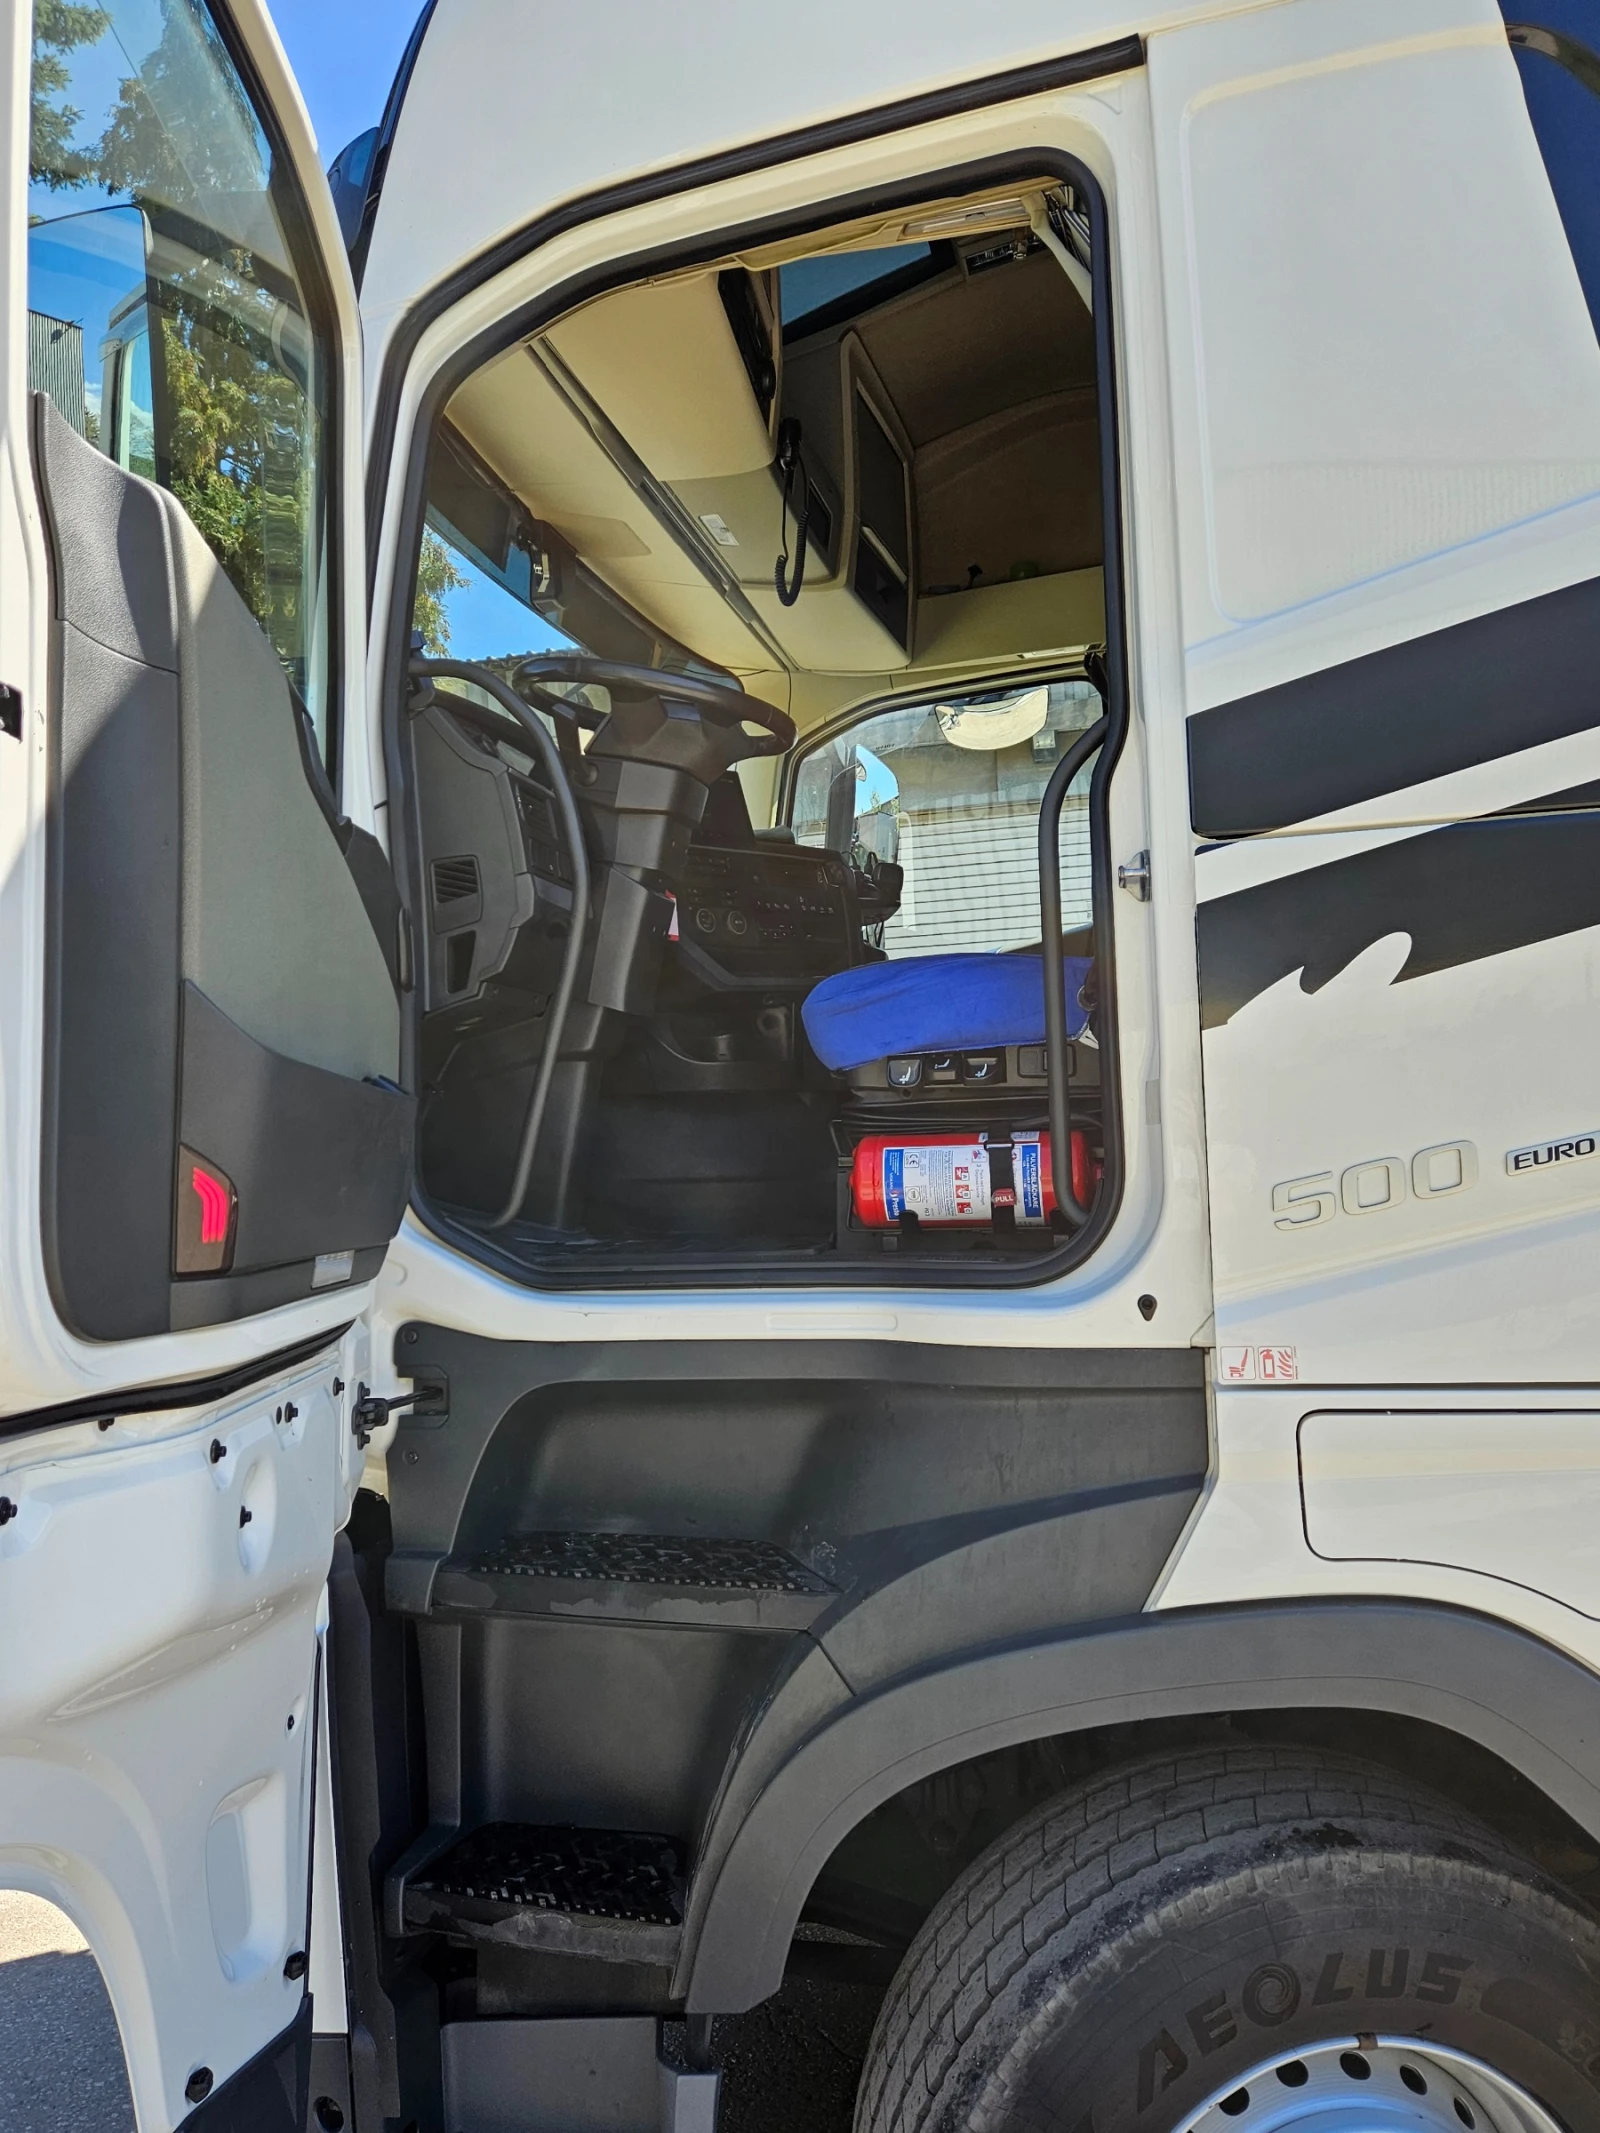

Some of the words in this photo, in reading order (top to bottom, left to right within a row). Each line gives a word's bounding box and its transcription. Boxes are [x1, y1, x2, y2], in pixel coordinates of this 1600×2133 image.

[1513, 1137, 1596, 1171] EURO
[995, 1194, 1014, 1203] PULL
[1271, 1139, 1478, 1231] 500
[892, 1197, 900, 1217] Presto
[1137, 1948, 1476, 2114] AEOLUS
